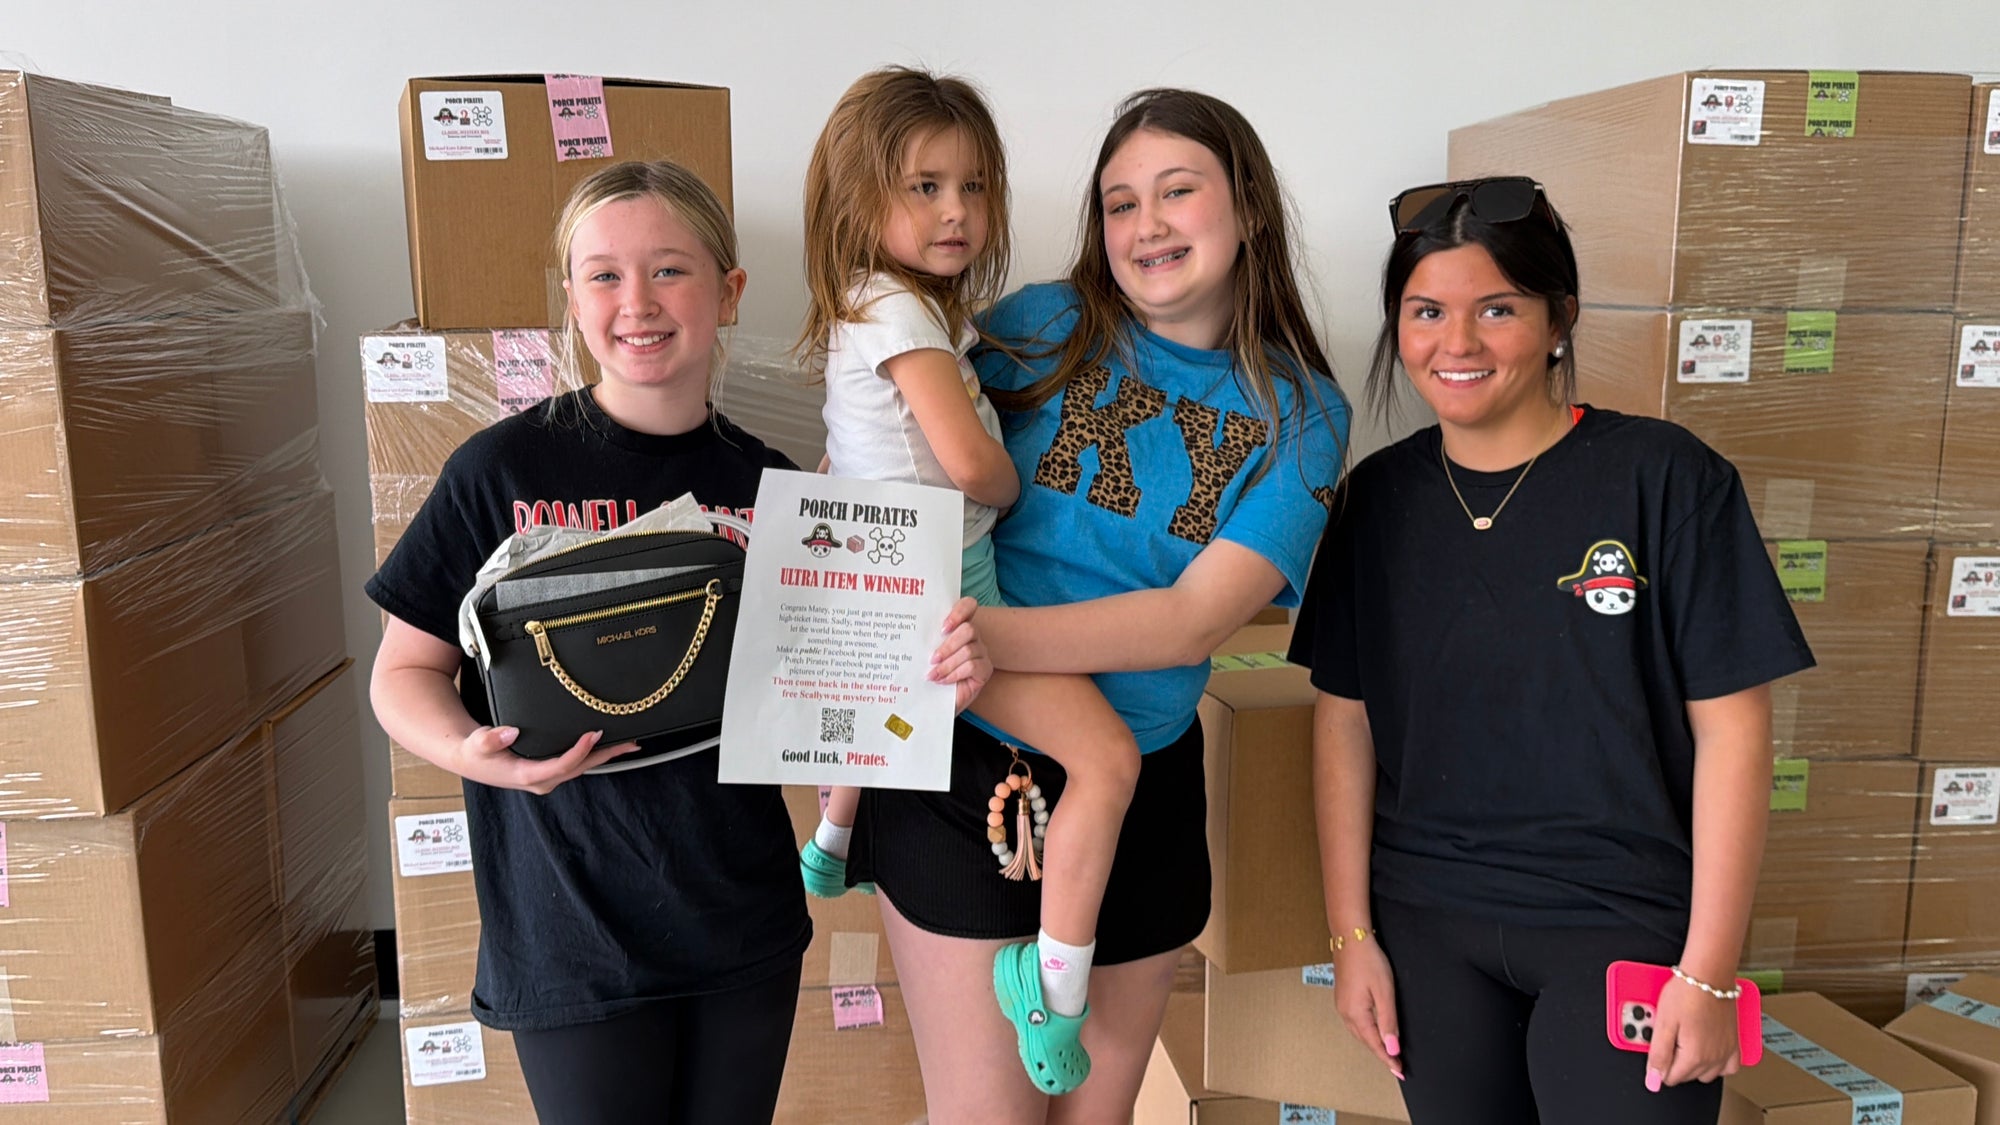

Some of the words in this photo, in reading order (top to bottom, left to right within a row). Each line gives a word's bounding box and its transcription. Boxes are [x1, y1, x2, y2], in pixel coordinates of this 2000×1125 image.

[552, 99, 575, 108] PORCH
[576, 96, 602, 106] PIRATES
[558, 138, 581, 147] PORCH
[582, 136, 608, 146] PIRATES
[1033, 366, 1269, 544] KY
[799, 498, 848, 521] PORCH
[852, 503, 918, 528] PIRATES
[780, 567, 819, 587] ULTRA
[823, 570, 858, 590] ITEM
[863, 574, 925, 596] WINNER!
[780, 603, 807, 613] Congrats
[832, 608, 845, 616] you
[846, 608, 860, 617] just
[862, 610, 873, 618] got
[884, 612, 917, 620] awesome
[779, 614, 811, 623] high-ticket
[873, 621, 897, 630] people
[898, 621, 916, 631] don't
[596, 631, 634, 646] MICHAEL
[634, 625, 657, 638] KORS
[790, 624, 798, 632] let
[799, 625, 809, 633] the
[810, 626, 830, 634] world
[832, 627, 850, 635] know
[852, 629, 872, 638] when
[873, 630, 888, 640] they
[890, 632, 901, 641] get
[807, 638, 842, 647] something
[776, 645, 793, 653] Make
[799, 646, 822, 656] public
[823, 647, 856, 657] Facebook
[858, 651, 873, 659] post
[889, 653, 900, 662] tag
[901, 653, 913, 661] the
[785, 656, 804, 664] Porch
[806, 657, 829, 666] Pirates
[831, 658, 863, 668] Facebook
[865, 662, 882, 671] page
[884, 663, 900, 671] with
[789, 666, 816, 676] pictures
[826, 670, 842, 678] your
[843, 669, 857, 677] box
[858, 671, 871, 679] and
[773, 677, 794, 686] Then
[818, 679, 838, 688] back
[840, 680, 849, 689] in
[850, 681, 864, 690] the
[866, 683, 887, 691] store
[889, 684, 902, 693] for
[782, 689, 798, 698] free
[800, 690, 841, 701] Scallywag
[842, 694, 876, 704] mystery
[878, 695, 897, 704] box!
[781, 749, 810, 763] Good
[813, 750, 843, 765] Luck,
[846, 752, 889, 767] Pirates.
